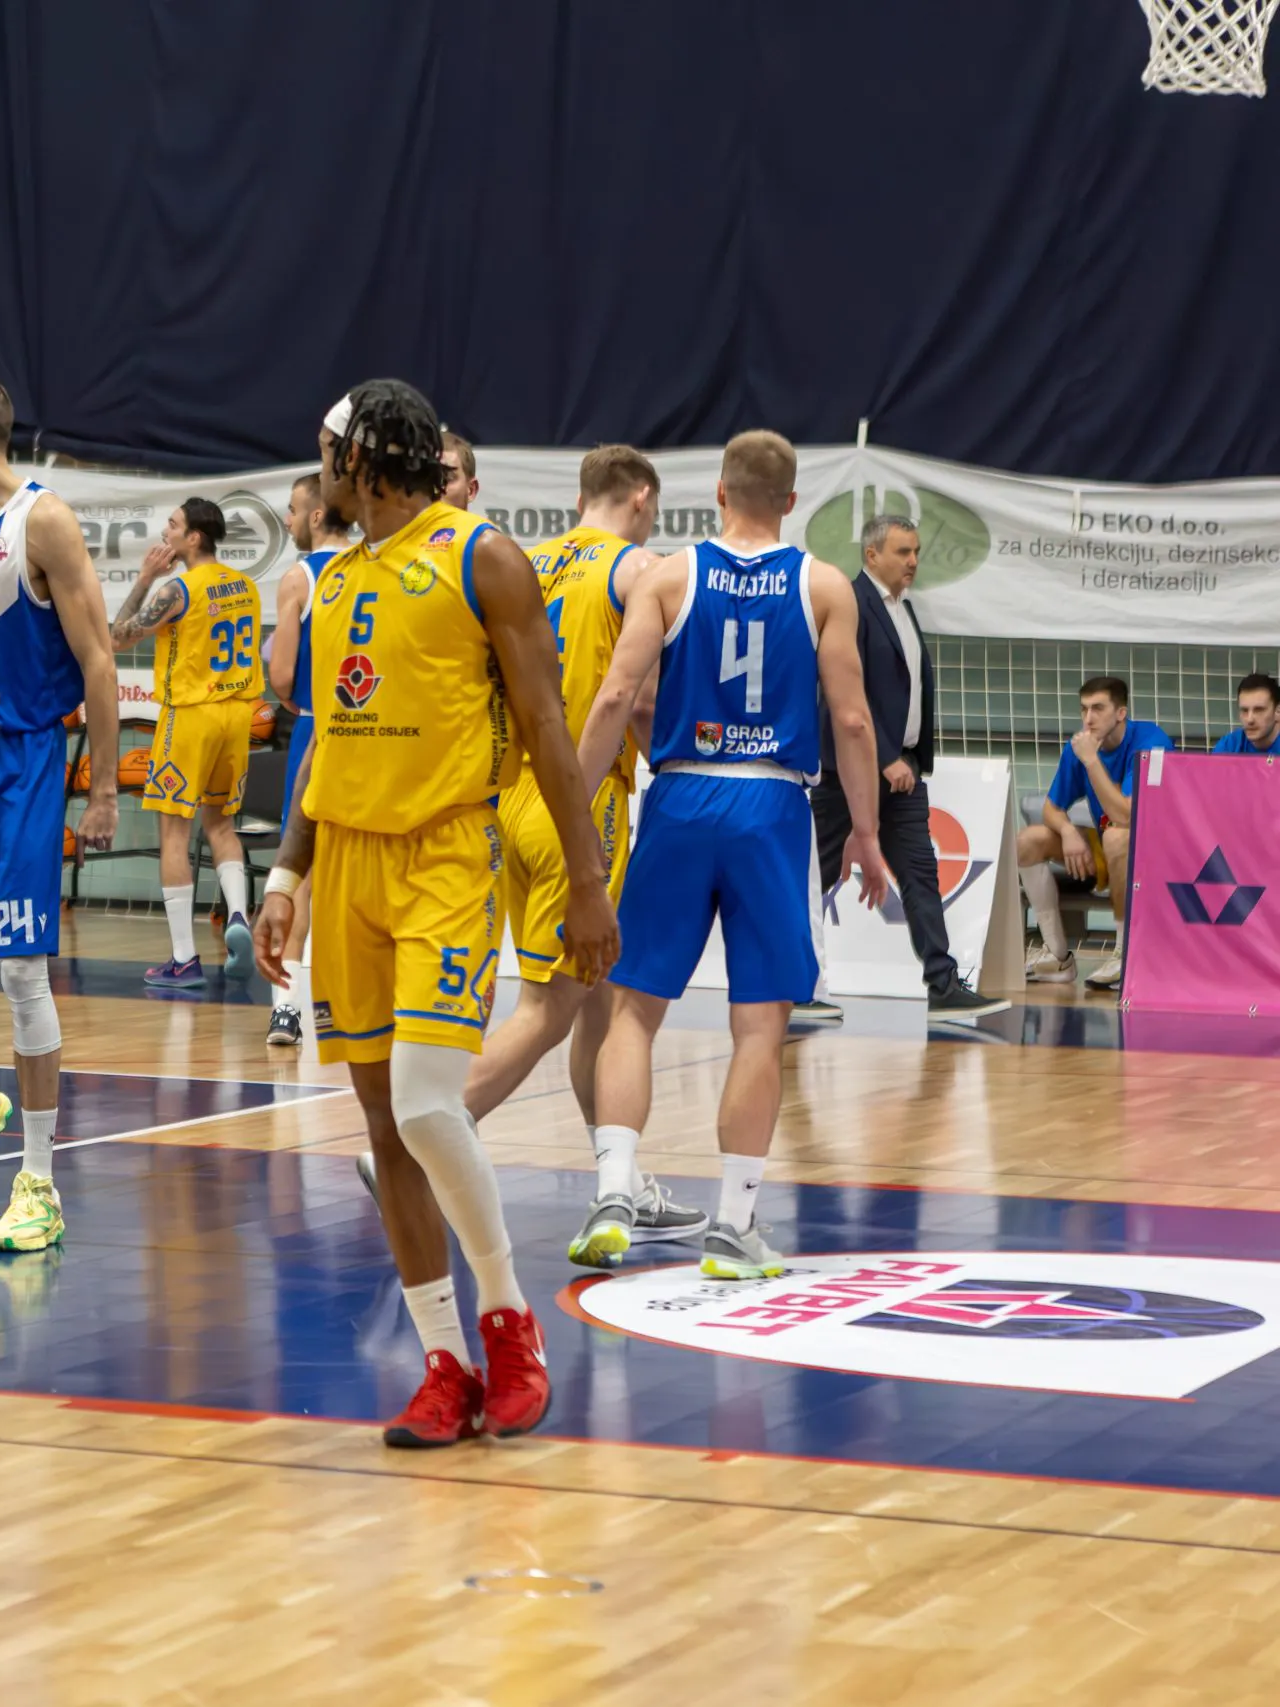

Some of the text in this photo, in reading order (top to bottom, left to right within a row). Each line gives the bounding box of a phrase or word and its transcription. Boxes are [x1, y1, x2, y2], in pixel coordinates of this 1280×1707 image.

[73, 503, 154, 521] upa
[485, 508, 580, 538] ROB
[1103, 513, 1153, 534] EKO
[1161, 515, 1225, 536] d.o.o.
[997, 539, 1021, 556] za
[1029, 537, 1160, 566] dezinfekciju,
[707, 567, 788, 598] KALAJŽIĆ
[1093, 568, 1217, 595] deratizaciju
[349, 592, 378, 645] 5
[210, 616, 253, 672] 33
[719, 618, 765, 713] 4
[330, 712, 379, 723] HOLDING
[379, 727, 420, 737] OSIJEK
[726, 724, 774, 740] GRAD
[724, 739, 779, 755] ZADAR
[438, 947, 469, 996] 5
[695, 1260, 966, 1337] FAVBET
